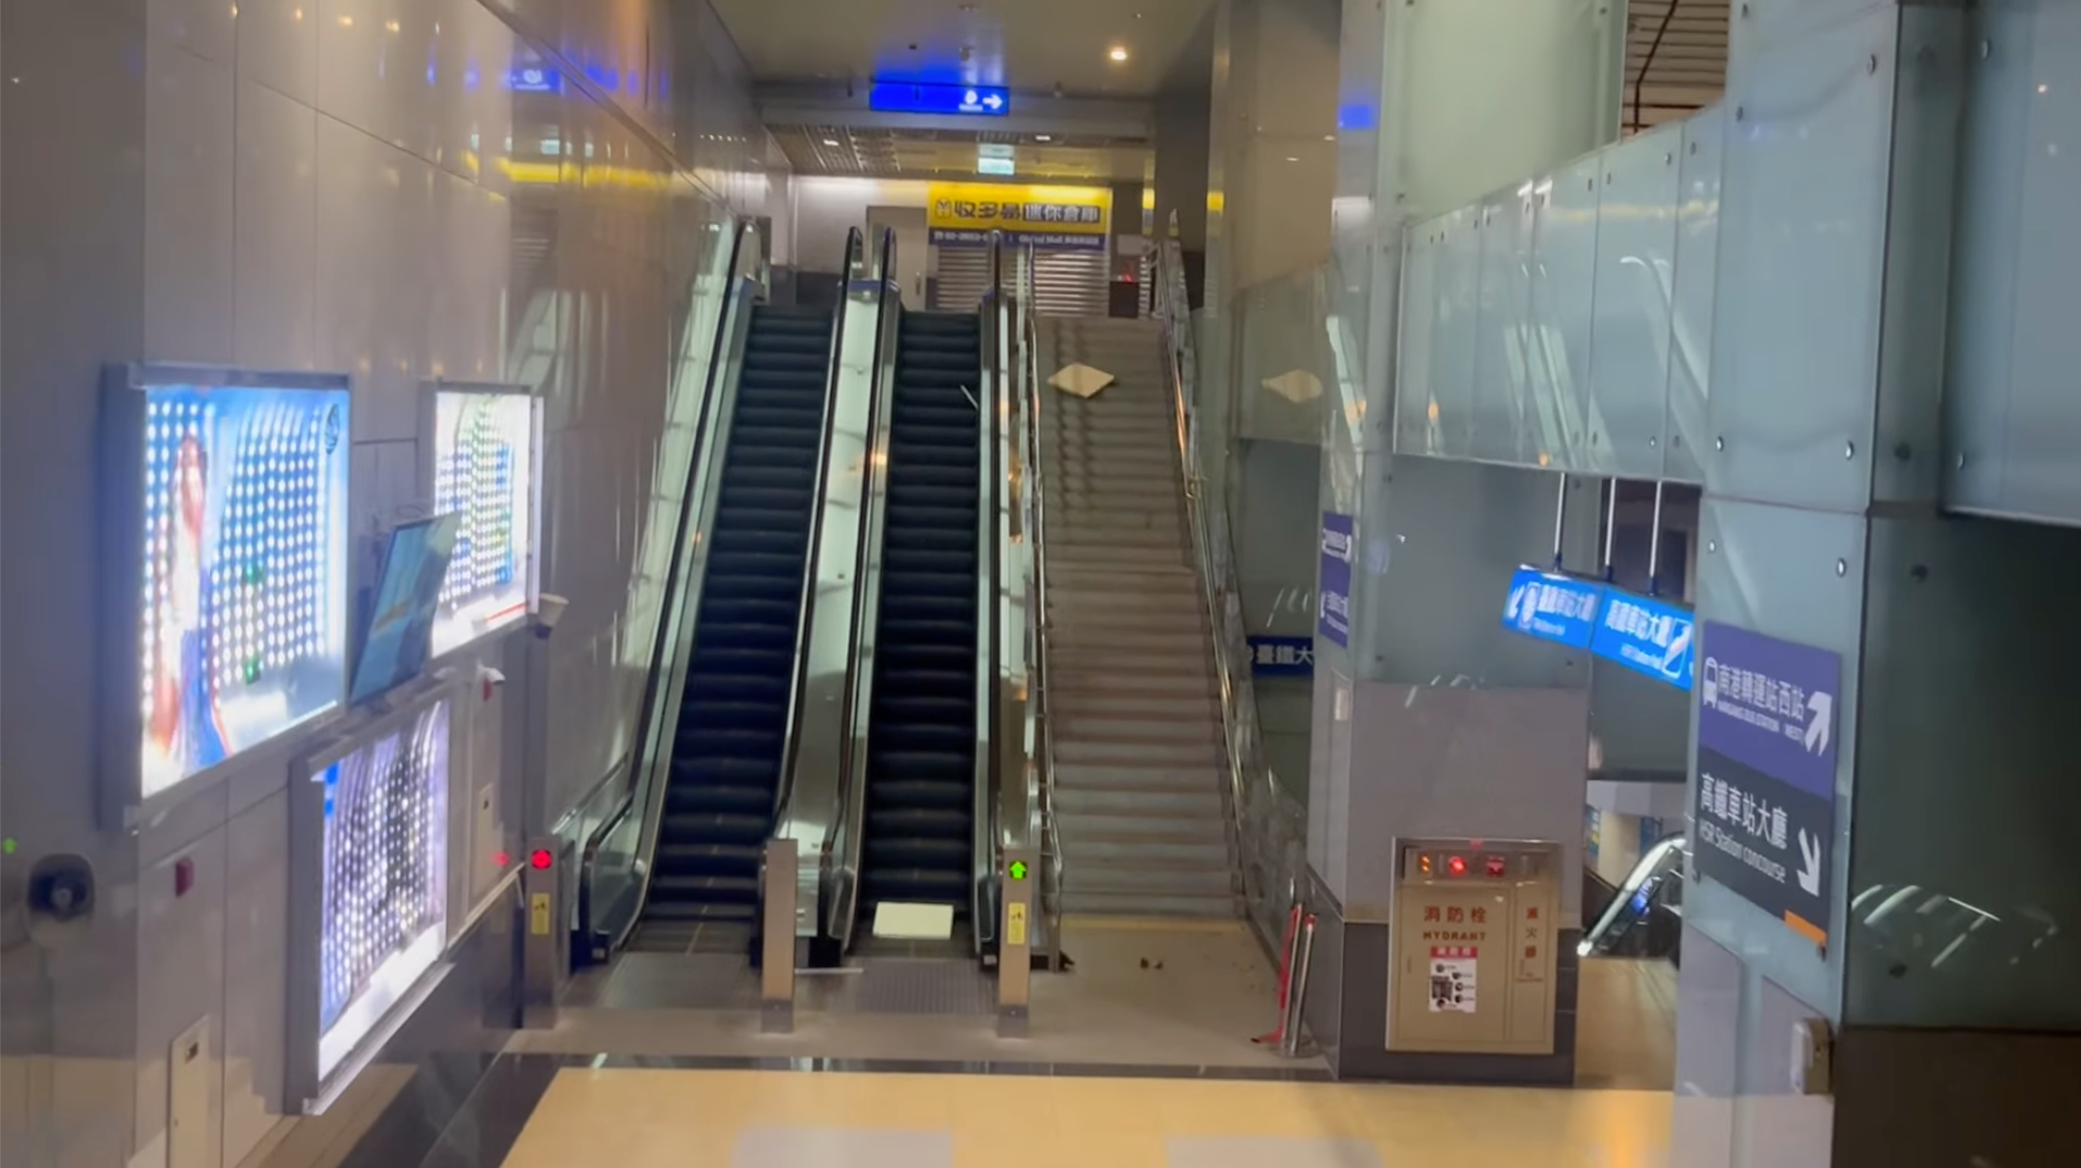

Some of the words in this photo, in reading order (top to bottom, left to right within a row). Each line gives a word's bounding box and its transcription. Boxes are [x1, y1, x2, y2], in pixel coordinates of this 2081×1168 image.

[1701, 773, 1788, 850] 高鐵車站大廳
[1424, 906, 1487, 923] 消防栓
[1423, 931, 1487, 941] HYDRANT
